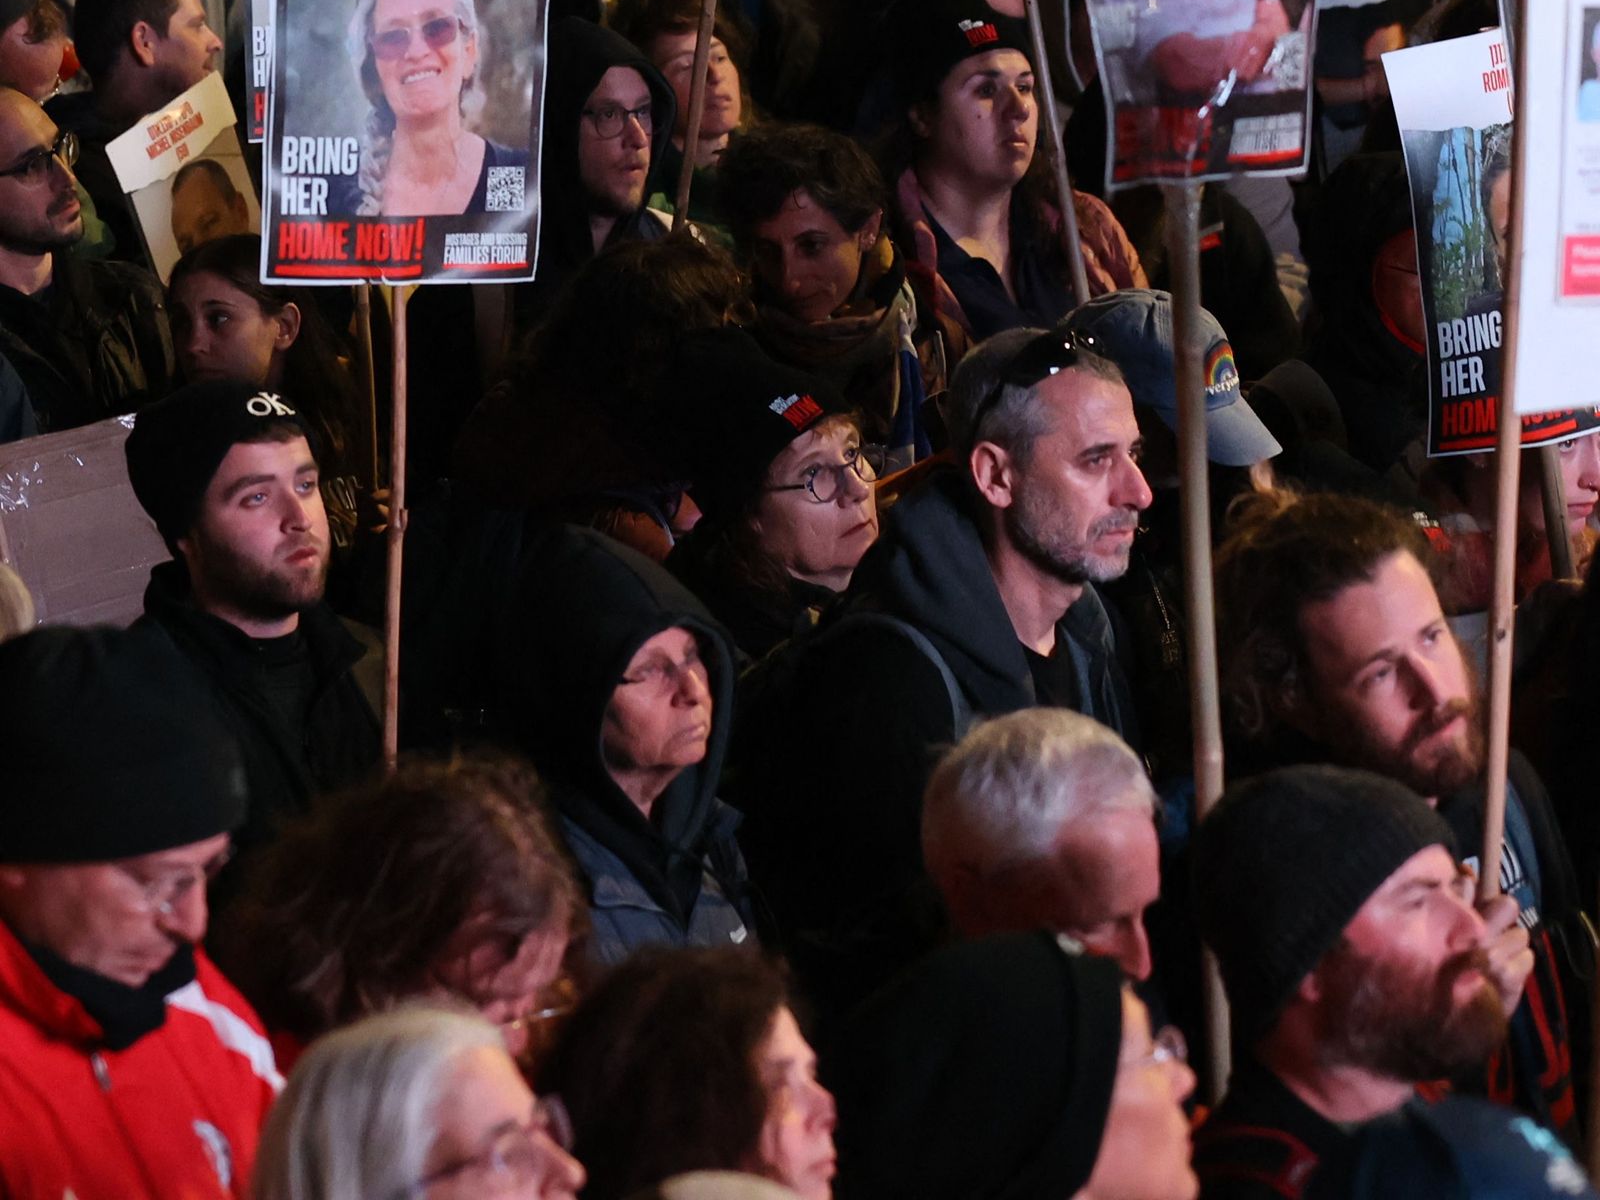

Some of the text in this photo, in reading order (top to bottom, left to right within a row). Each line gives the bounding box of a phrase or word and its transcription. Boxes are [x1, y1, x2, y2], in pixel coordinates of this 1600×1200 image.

[281, 136, 360, 175] BRING
[280, 177, 328, 216] HER
[278, 217, 425, 261] HOME NOW!
[444, 245, 527, 264] FAMILIES FORUM
[1437, 310, 1502, 359] BRING
[1441, 356, 1486, 398] HER
[246, 391, 296, 416] OK
[1442, 397, 1498, 436] HOM
